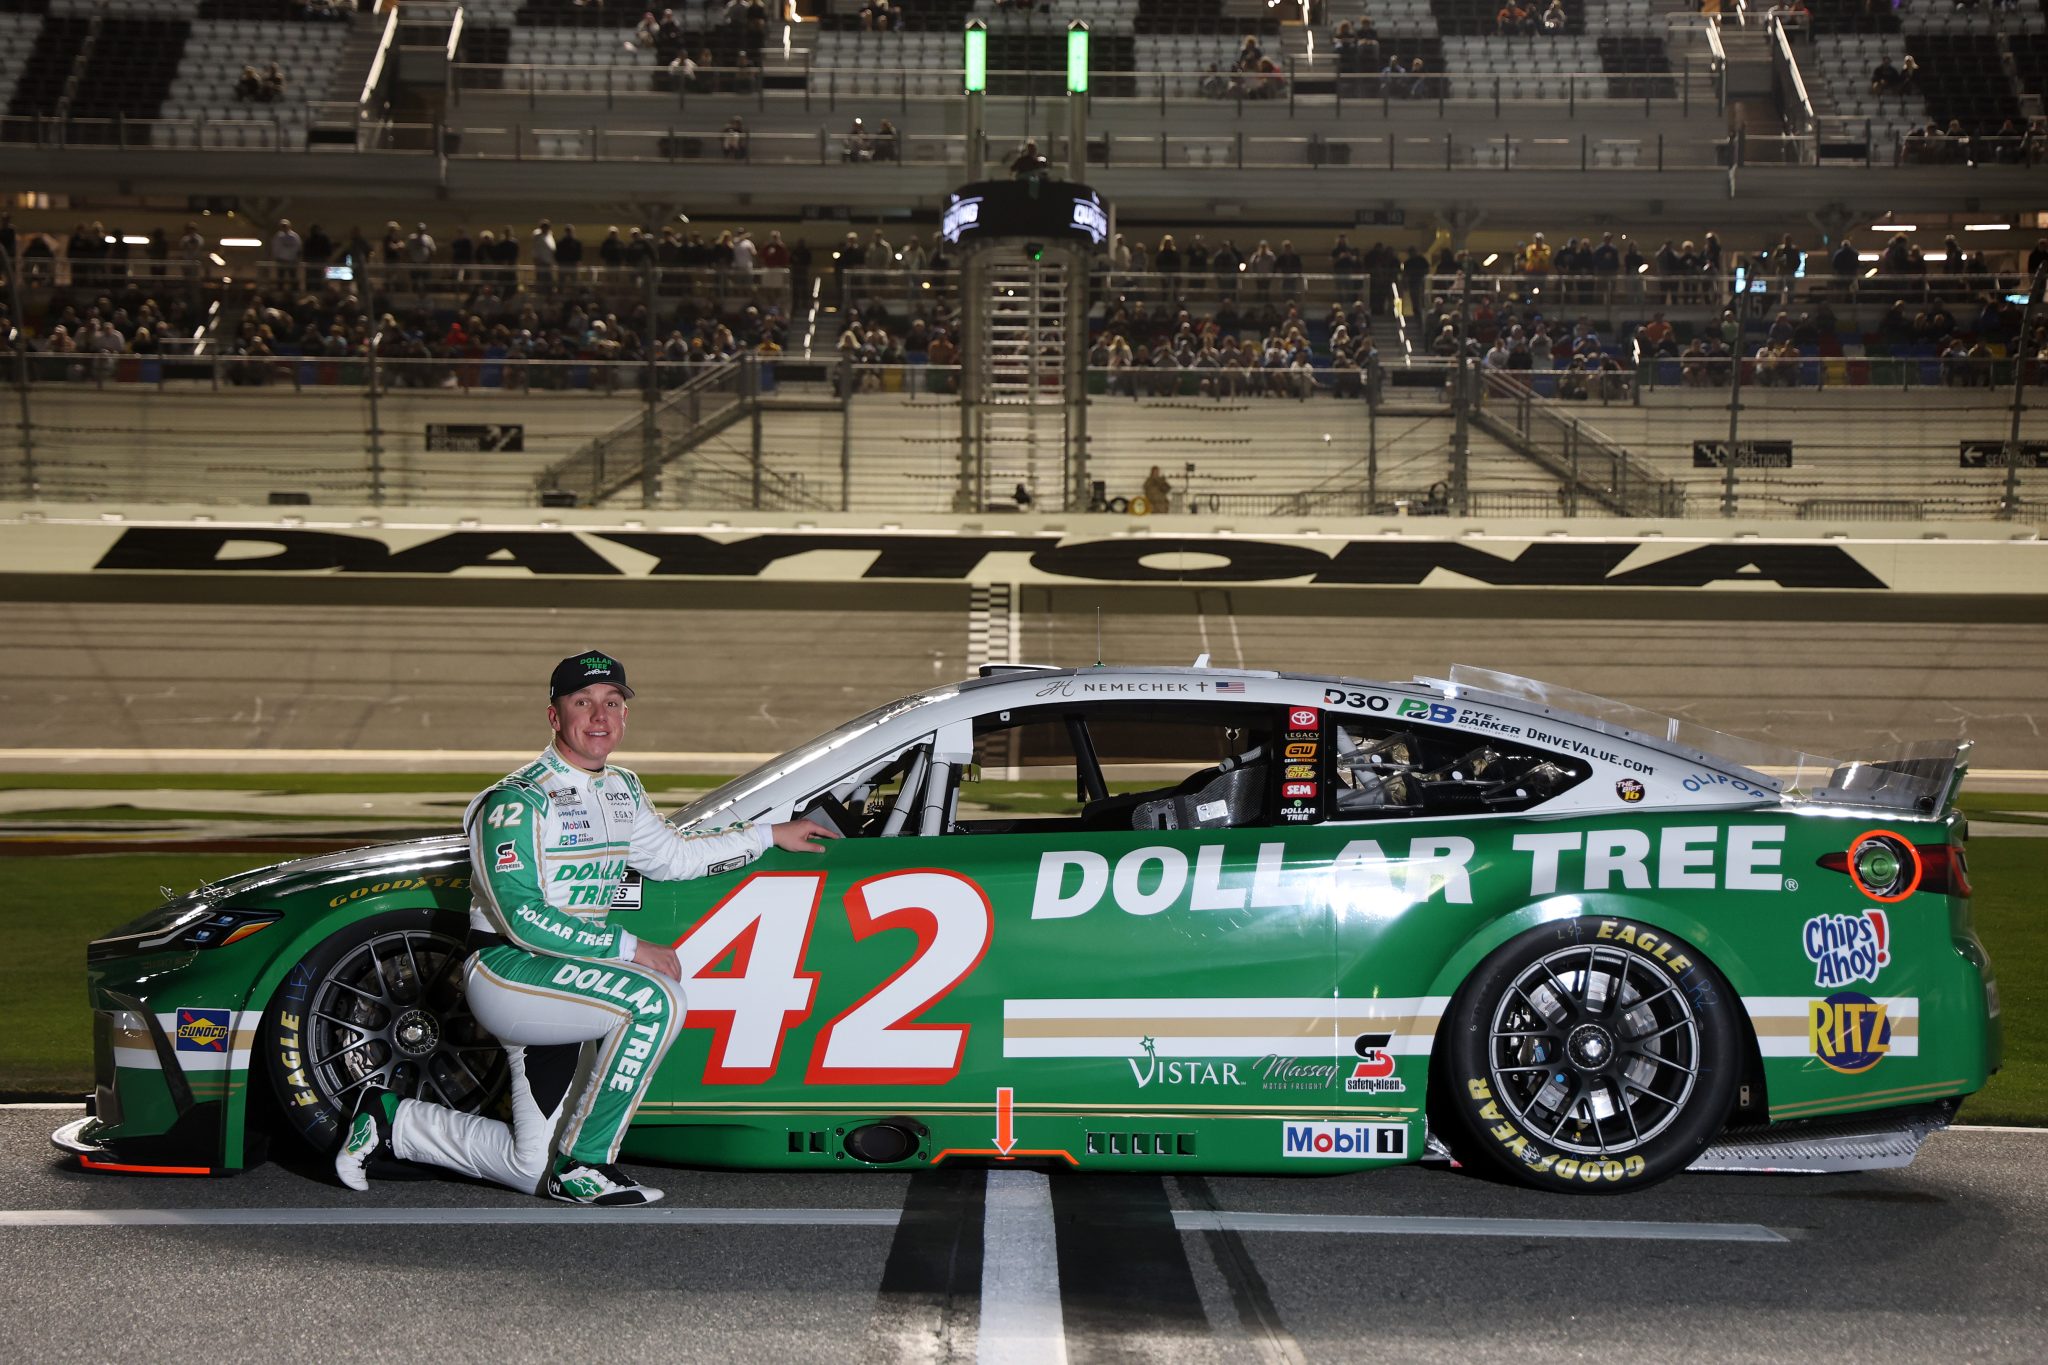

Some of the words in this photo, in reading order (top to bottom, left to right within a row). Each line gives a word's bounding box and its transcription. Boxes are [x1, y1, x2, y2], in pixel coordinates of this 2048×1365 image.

[1986, 454, 2037, 468] SECTONS
[92, 527, 1892, 590] DAYTONA
[580, 657, 613, 666] DOLLAR
[1084, 683, 1189, 692] NEMECHEK
[1285, 732, 1320, 740] LEGACY
[1458, 716, 1521, 735] BARKER
[1286, 785, 1312, 795] SEM
[1624, 791, 1640, 800] 16
[1682, 772, 1766, 799] OLIPOP
[488, 803, 524, 829] 42
[1281, 807, 1316, 815] DOLLAR
[562, 821, 583, 831] Mobil
[553, 860, 626, 882] DOLLA
[1031, 836, 1475, 921] DOLLAR
[329, 876, 471, 908] GOODYE
[575, 930, 614, 947] TREE
[1596, 920, 1692, 973] EAGLE
[1805, 916, 1872, 959] Chips
[672, 867, 994, 1085] 42
[179, 1026, 226, 1038] SUNOCO
[551, 963, 662, 1015] DOLLAR
[609, 1021, 661, 1092] TREE
[1808, 1000, 1891, 1057] RITZ
[279, 1010, 319, 1108] EAGLE
[1252, 1053, 1341, 1090] Massey
[1262, 1082, 1287, 1090] MOTOR
[1290, 1082, 1323, 1090] FREIGHT
[1287, 1127, 1370, 1154] Mobil
